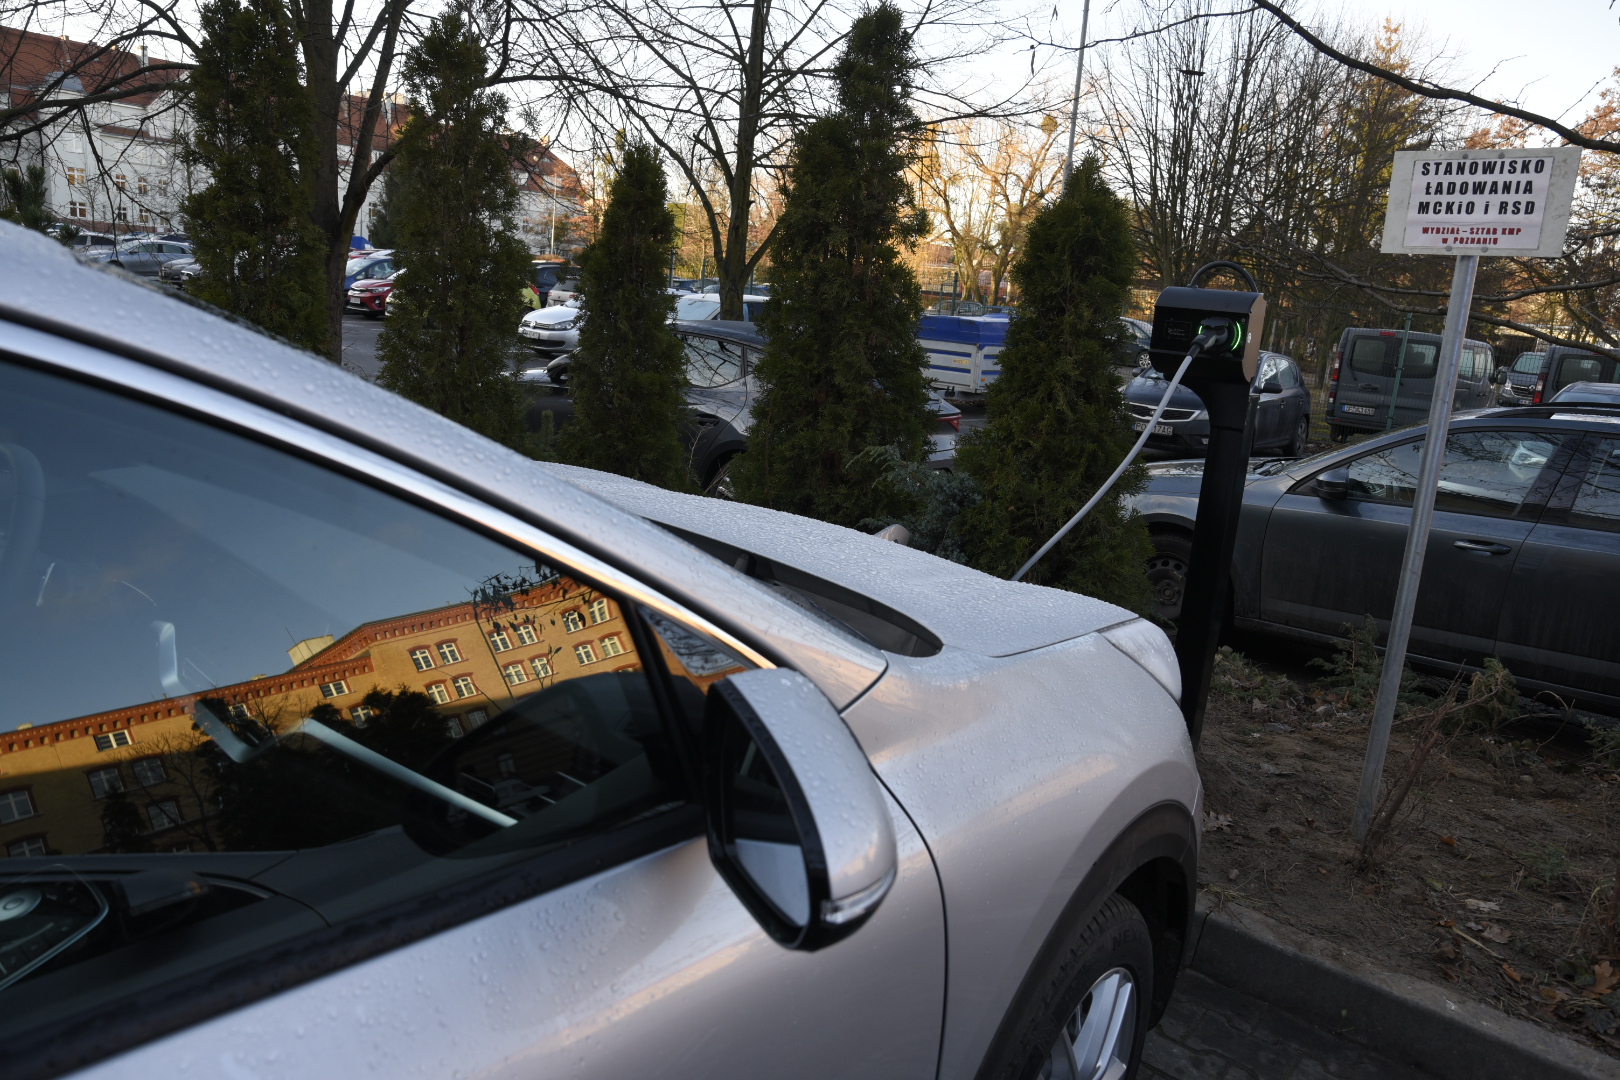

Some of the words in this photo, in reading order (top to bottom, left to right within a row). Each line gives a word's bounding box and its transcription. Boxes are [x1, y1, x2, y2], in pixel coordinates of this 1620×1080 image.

[1421, 159, 1545, 176] STANOWISKO
[1425, 181, 1533, 195] ŁADOWANIA
[1483, 201, 1490, 215] i
[1498, 201, 1536, 215] RSD
[1422, 226, 1460, 235] WYDZIAŁ
[1469, 227, 1498, 236] SZTAB
[1501, 227, 1522, 236] KMP
[1453, 236, 1499, 245] POZNANIU
